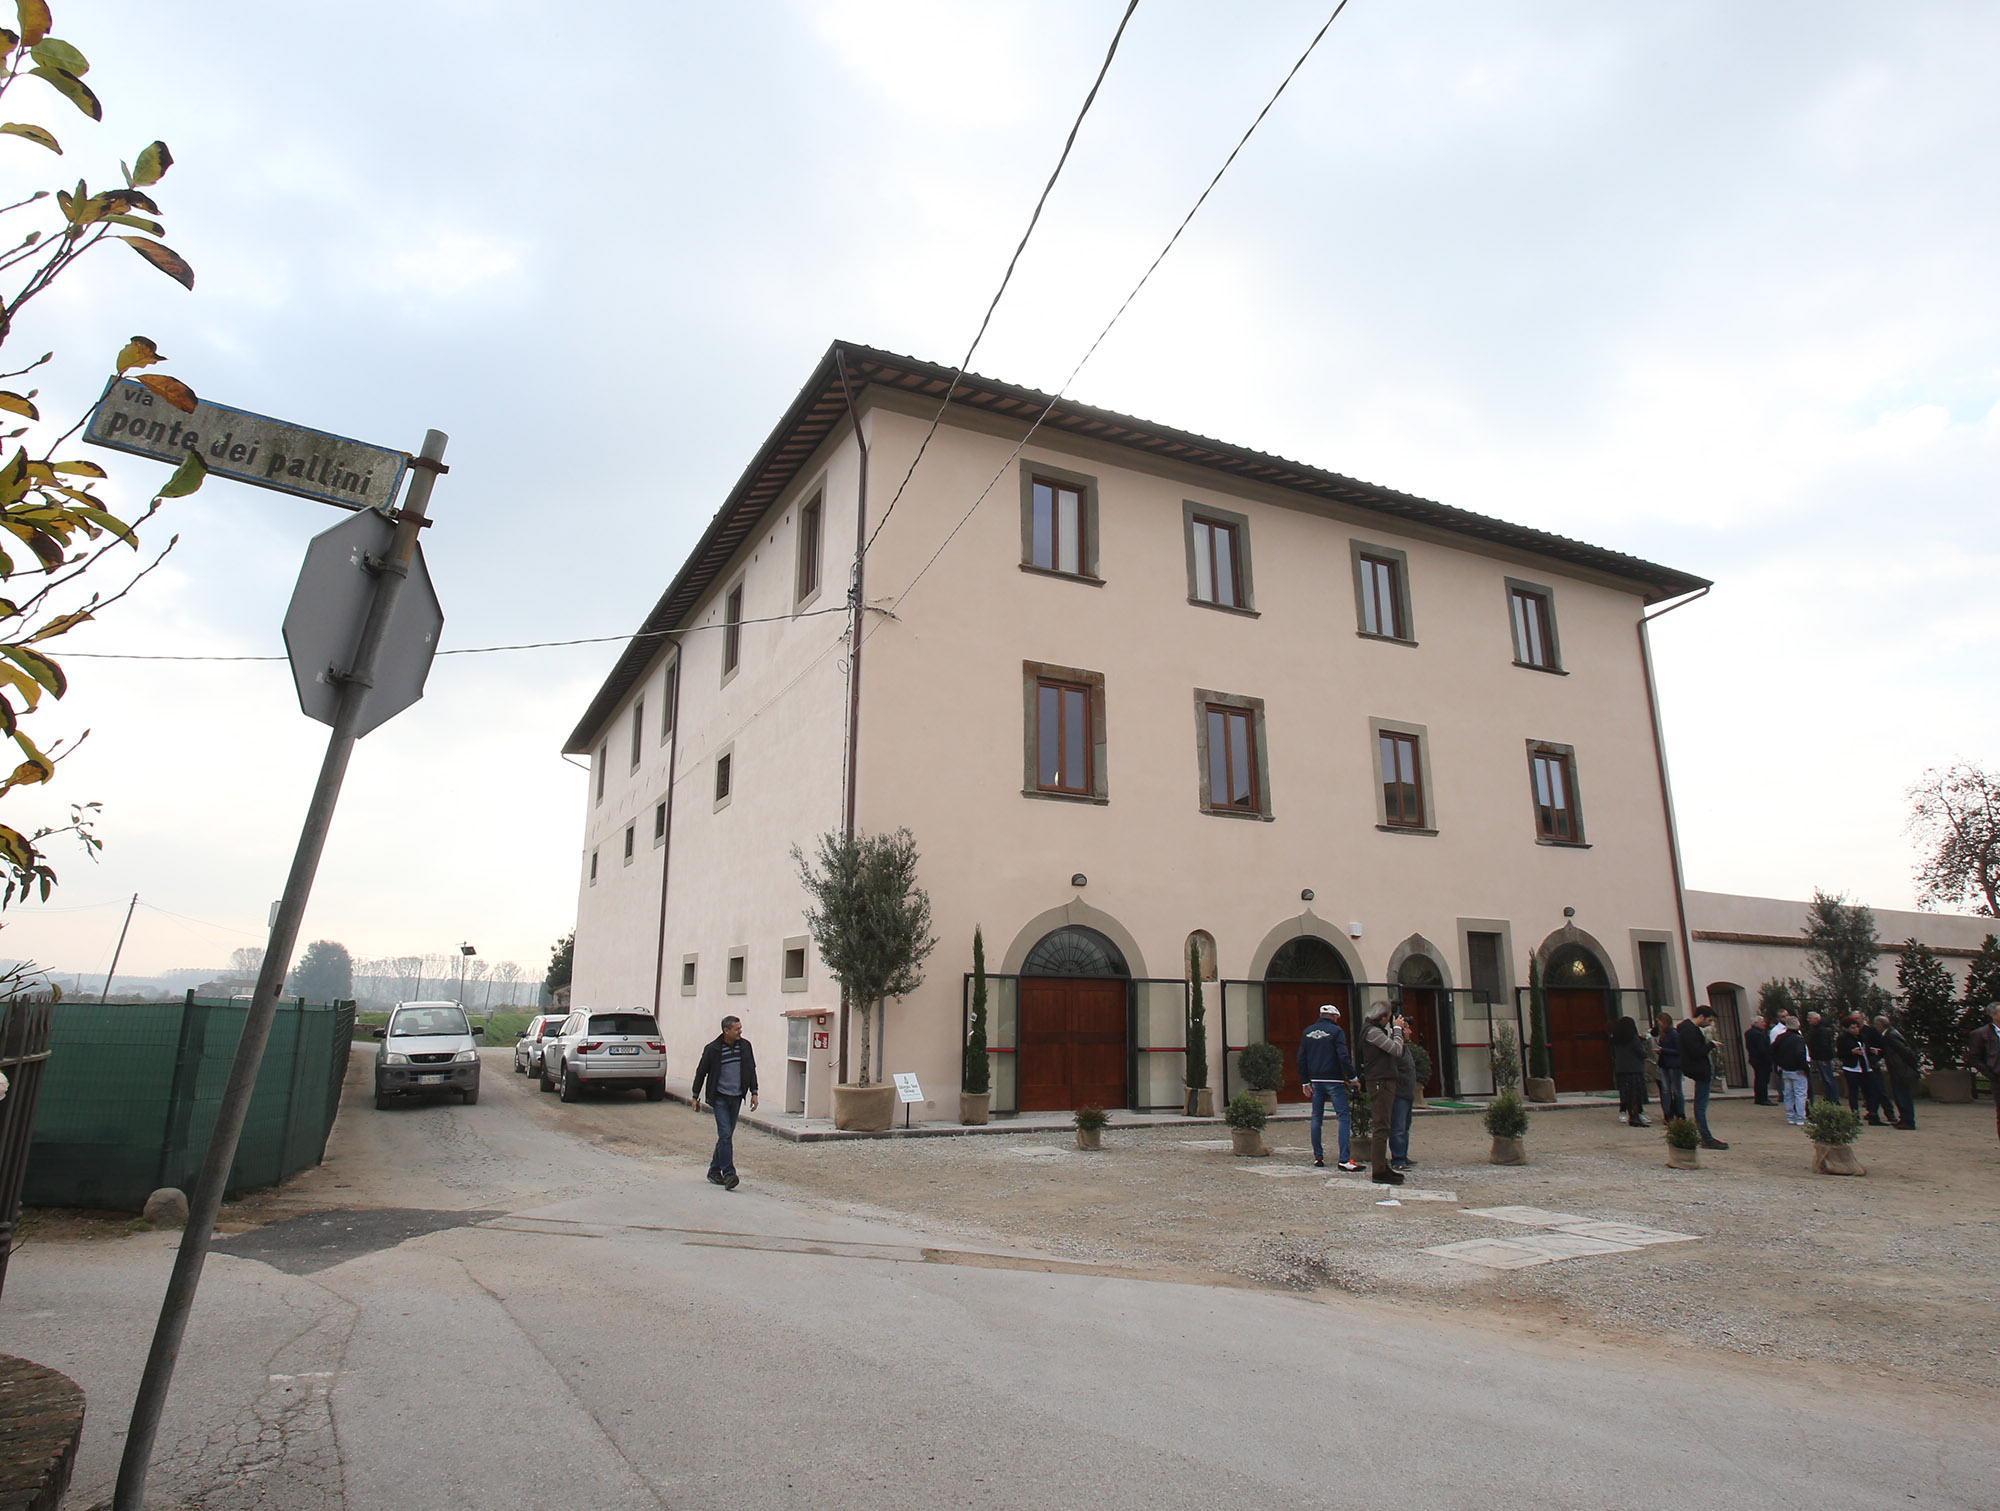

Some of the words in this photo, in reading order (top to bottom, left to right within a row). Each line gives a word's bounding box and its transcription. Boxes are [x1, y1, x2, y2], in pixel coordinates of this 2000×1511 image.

[125, 388, 154, 407] via
[105, 411, 199, 450] ponte
[210, 432, 261, 465] dei
[265, 452, 374, 495] pallini
